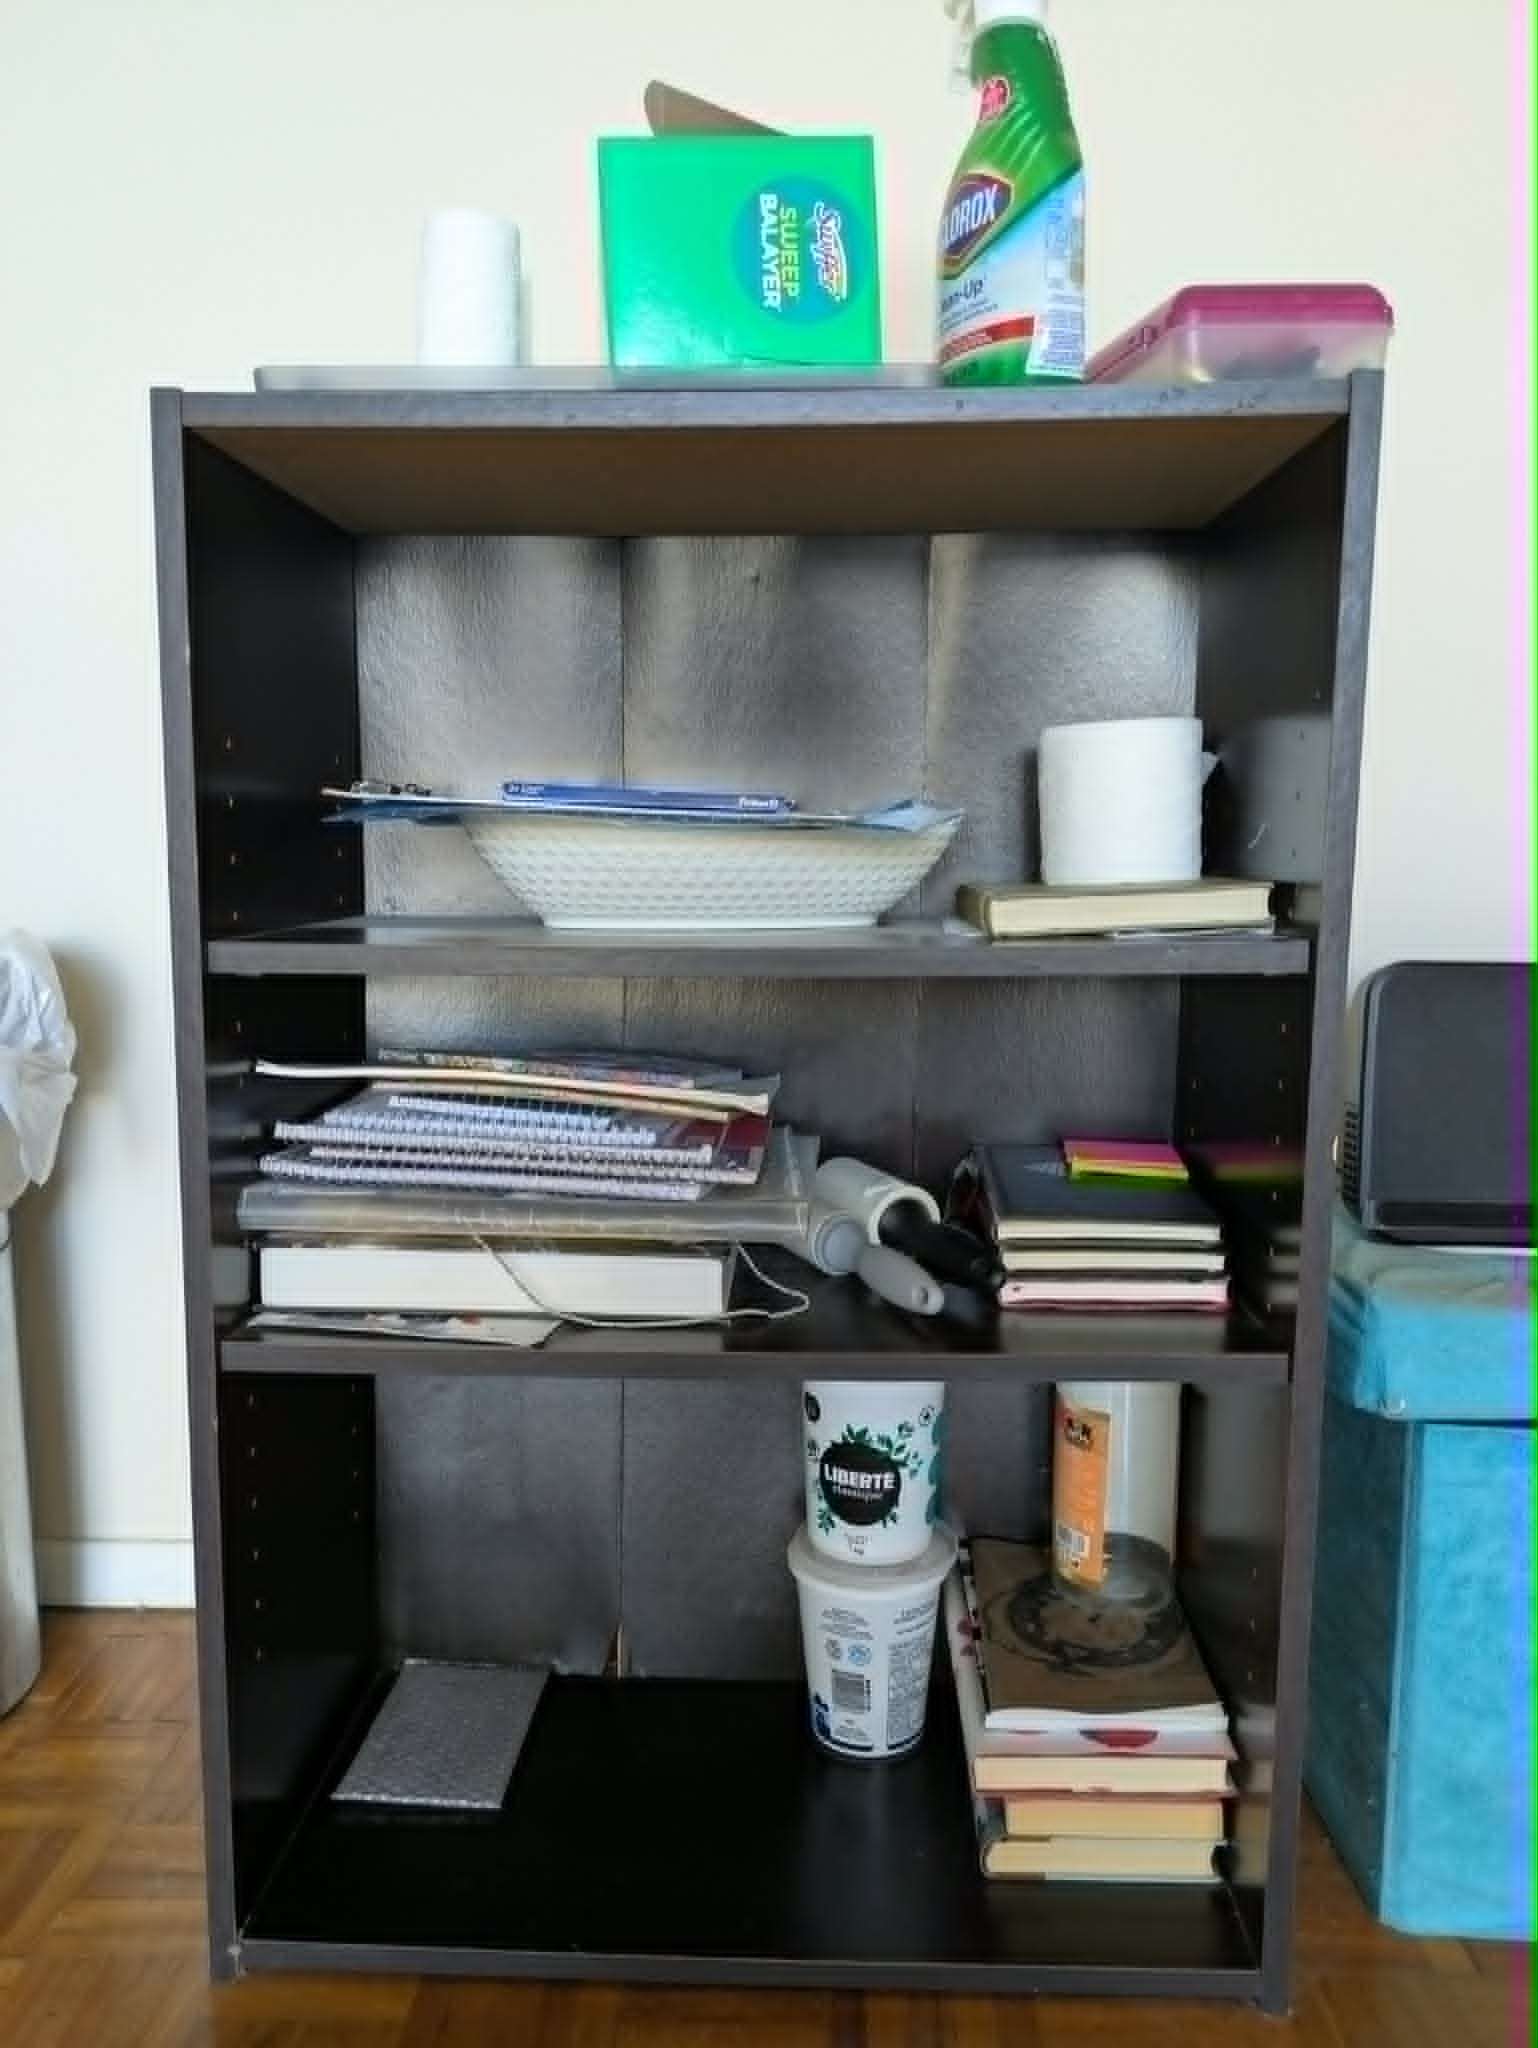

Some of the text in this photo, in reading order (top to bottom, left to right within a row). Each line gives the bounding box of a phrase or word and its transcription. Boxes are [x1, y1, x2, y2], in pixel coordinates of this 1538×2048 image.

[760, 193, 782, 312] BALAYER
[779, 207, 800, 297] SWEEP
[942, 184, 998, 249] LOROX
